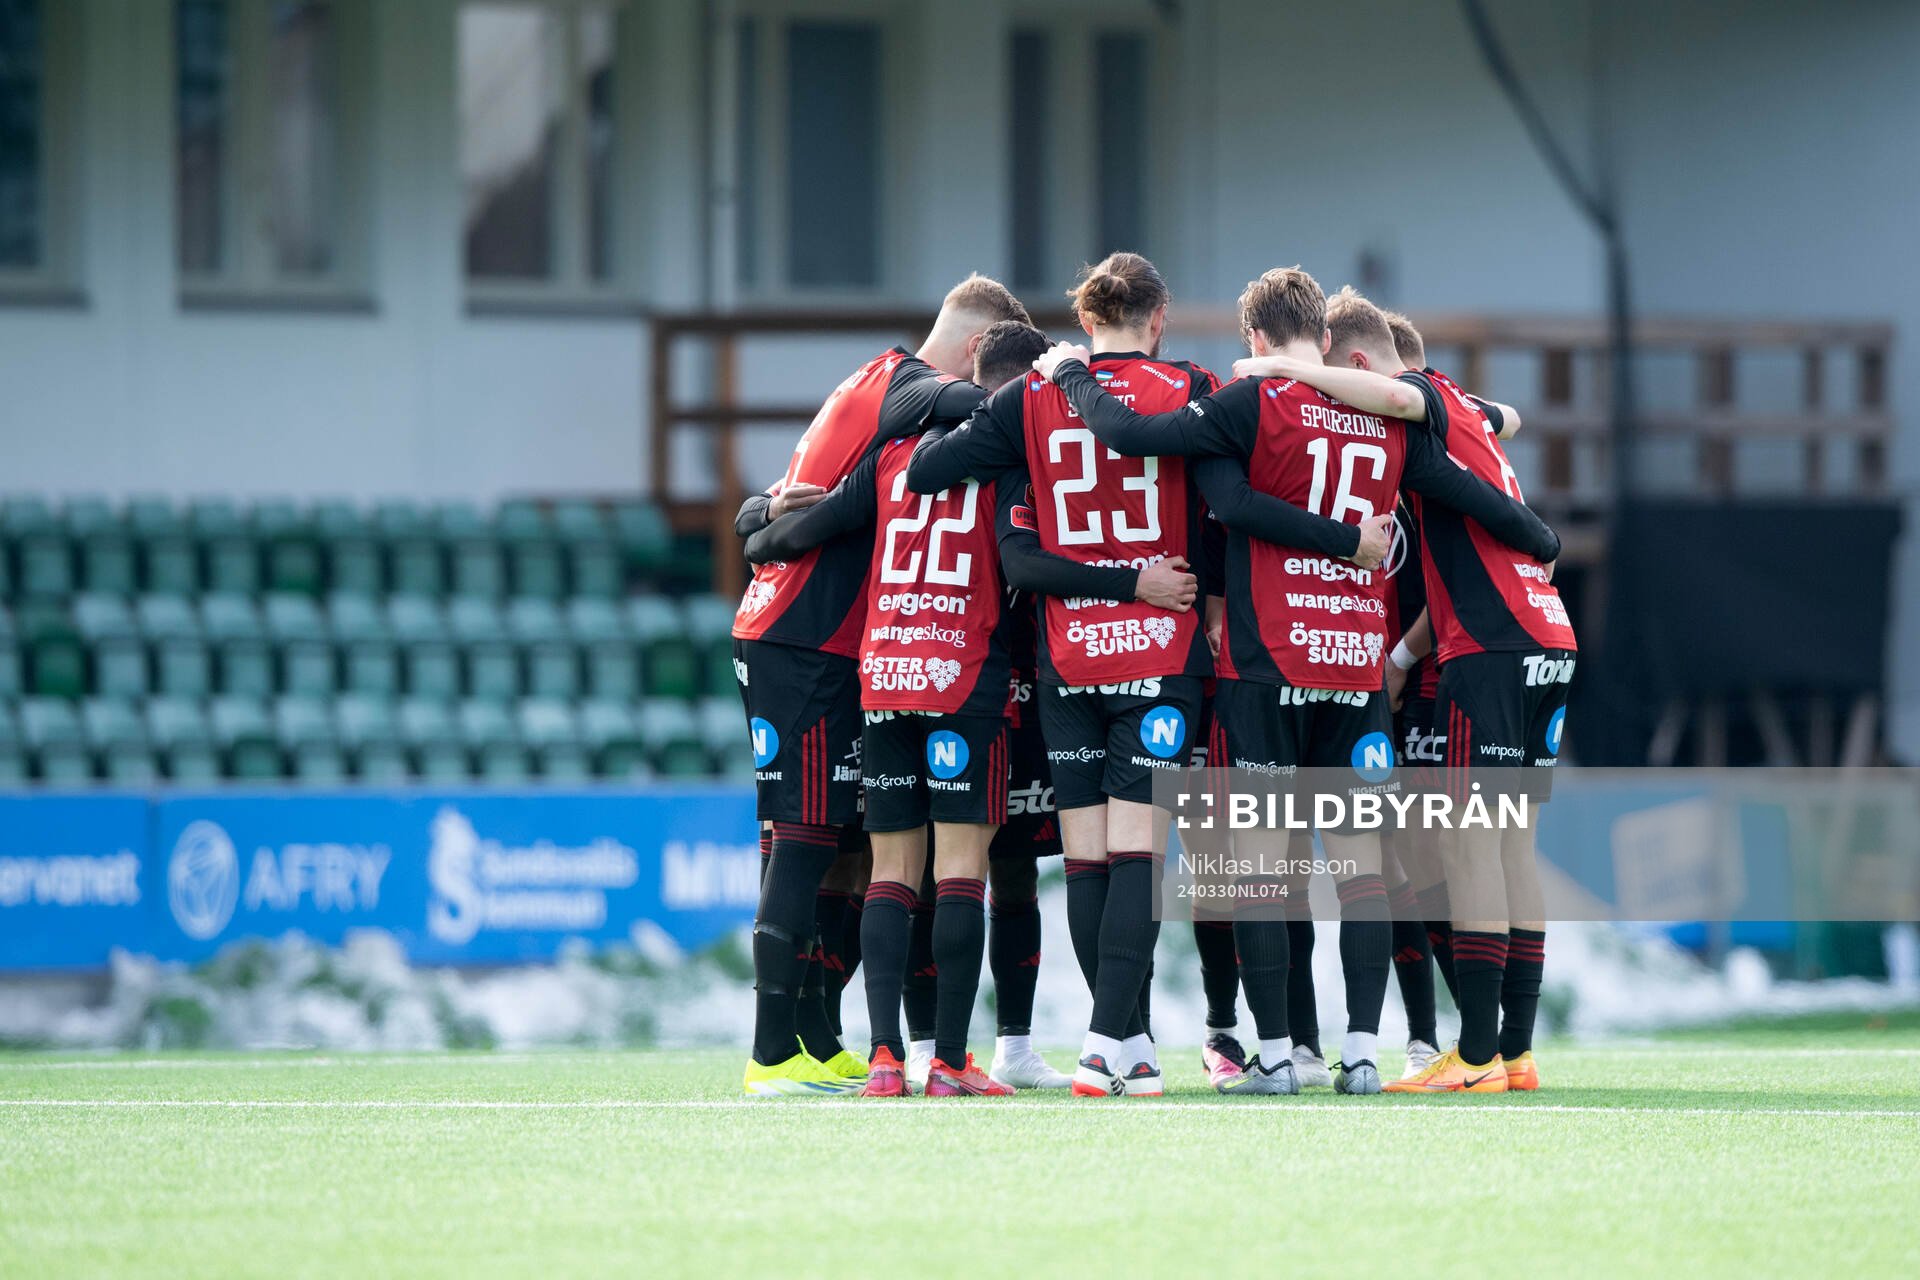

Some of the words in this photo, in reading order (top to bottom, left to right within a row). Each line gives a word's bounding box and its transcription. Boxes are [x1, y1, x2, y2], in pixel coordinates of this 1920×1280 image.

[1301, 404, 1387, 439] SPORRONG
[1048, 428, 1161, 545] 23
[1306, 437, 1387, 528] 16
[880, 470, 980, 587] 22
[878, 592, 966, 616] engcon
[1286, 592, 1385, 618] wangeskog
[871, 623, 966, 648] wangeskog
[1067, 620, 1142, 643] ÖSTER
[1289, 622, 1363, 648] ÖSTER
[1085, 634, 1151, 657] SUND
[1308, 647, 1368, 667] SUND
[862, 651, 923, 675] ÖSTER
[871, 673, 928, 691] SUND
[1152, 717, 1179, 746] N
[934, 741, 956, 767] N
[1131, 756, 1181, 772] NIGHTLINE
[1364, 742, 1388, 770] N
[832, 764, 862, 782] Jäm
[245, 843, 390, 910] AFRY
